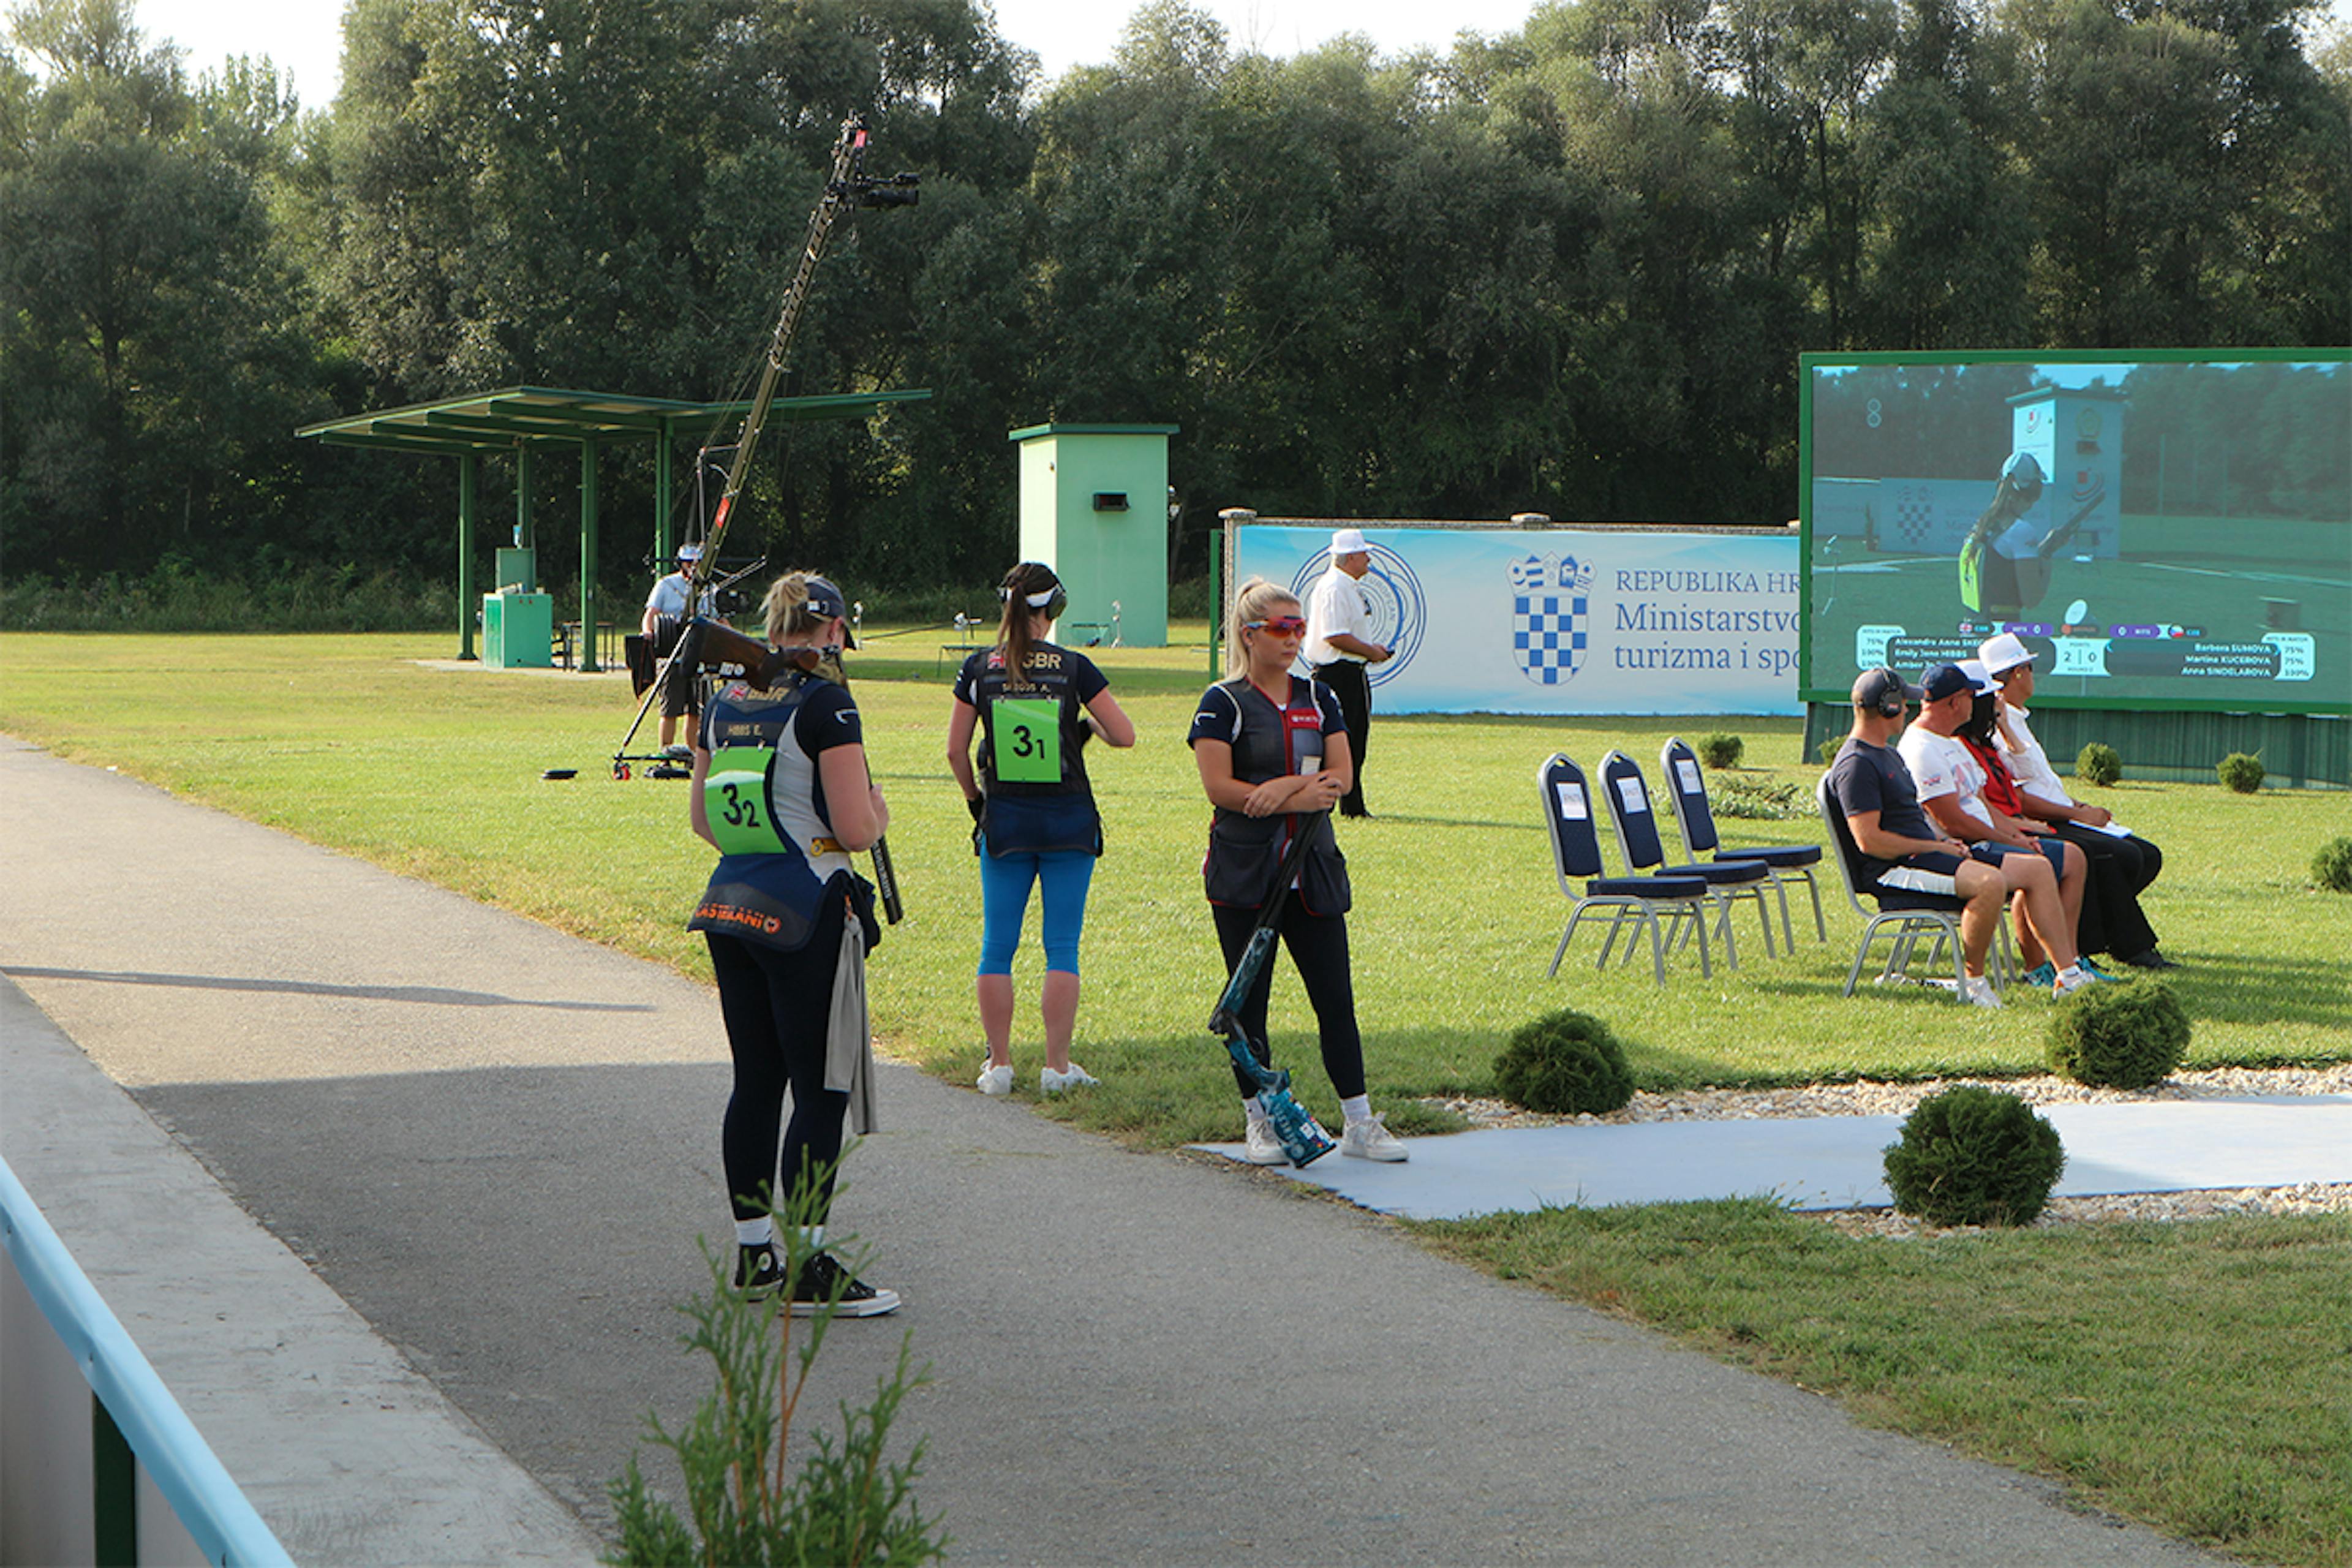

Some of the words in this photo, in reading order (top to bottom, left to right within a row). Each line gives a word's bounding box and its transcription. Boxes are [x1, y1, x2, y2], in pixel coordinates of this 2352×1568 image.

[1616, 570, 1759, 592] REPUBLIKA
[1615, 641, 1730, 669] turizma
[1741, 641, 1749, 669] i
[2064, 651, 2071, 662] 2
[2088, 652, 2097, 663] 0
